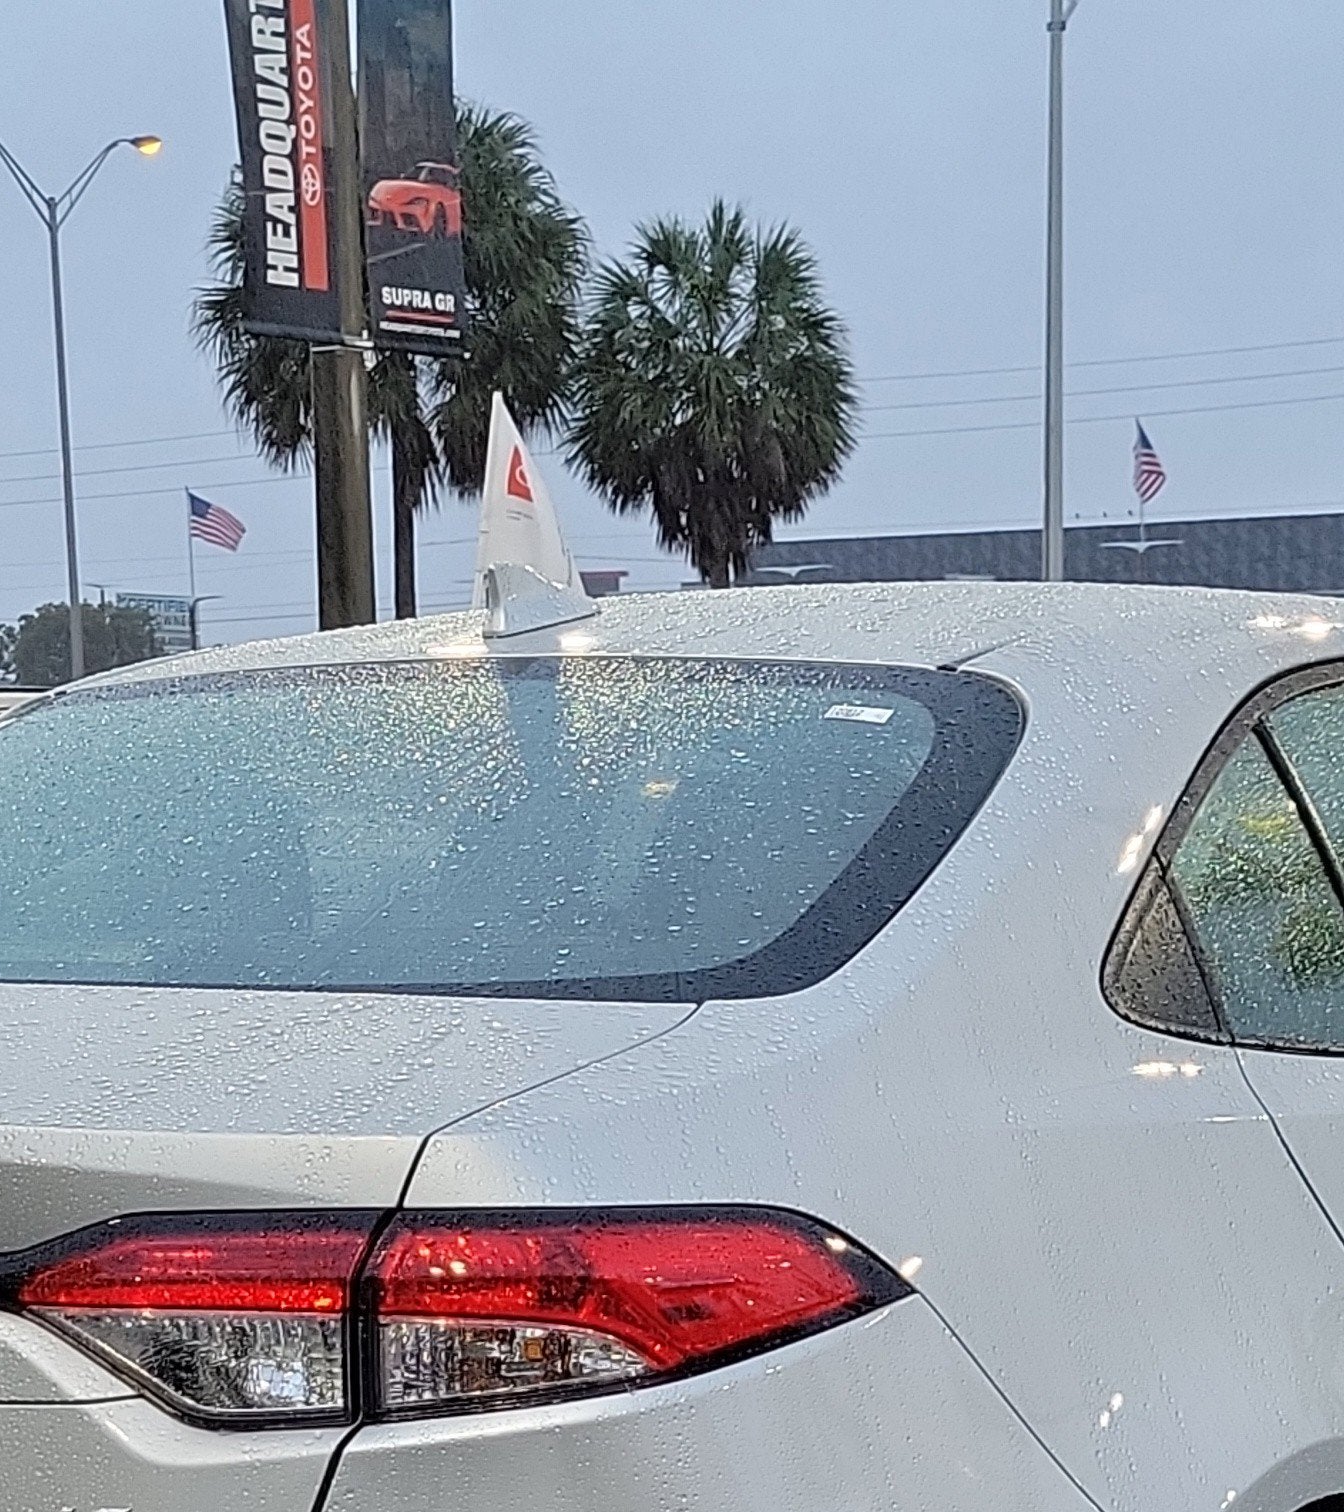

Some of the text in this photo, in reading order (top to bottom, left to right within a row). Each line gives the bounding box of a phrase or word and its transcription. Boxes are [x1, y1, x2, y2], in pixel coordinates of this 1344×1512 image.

[295, 22, 317, 159] TOYOTA
[381, 286, 455, 313] SUPRA GR
